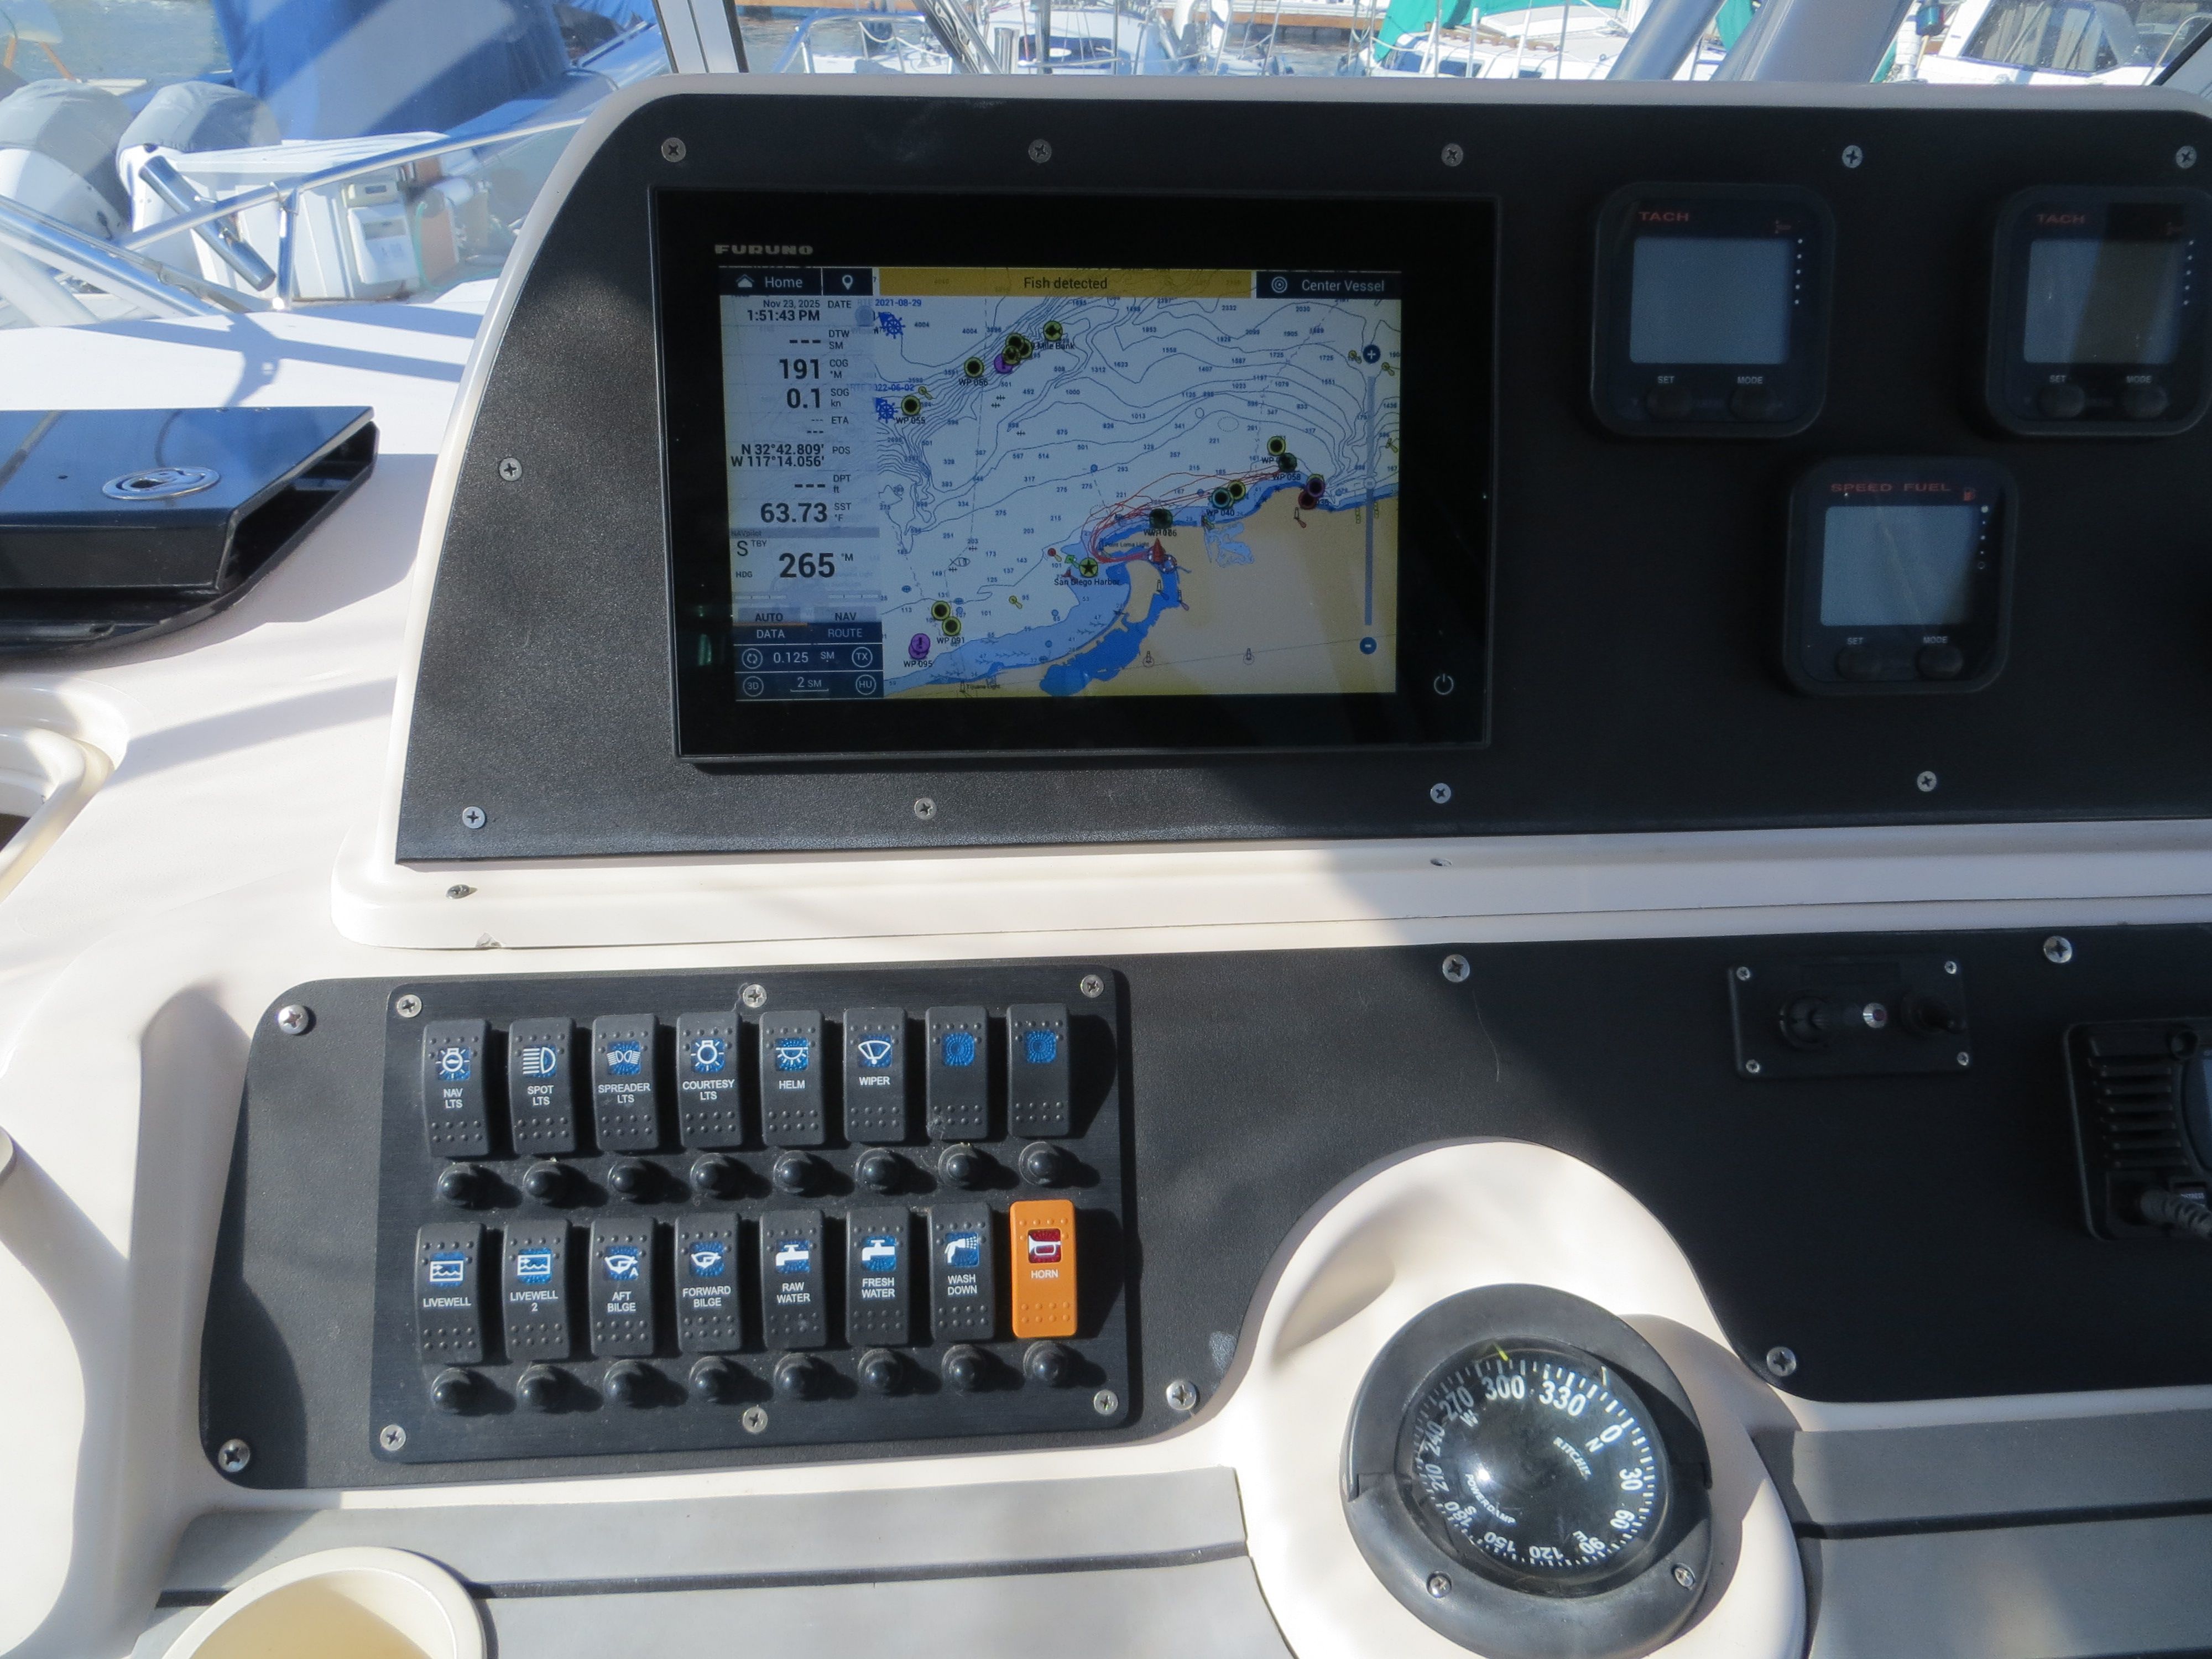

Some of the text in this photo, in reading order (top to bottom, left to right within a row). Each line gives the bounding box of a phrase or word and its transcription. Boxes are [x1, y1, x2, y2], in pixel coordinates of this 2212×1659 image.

[1639, 212, 1689, 221] TACH
[2037, 214, 2085, 224] TACH
[714, 244, 814, 255] FURUNO
[765, 276, 803, 288] Home
[1024, 277, 1107, 289] Fish detected
[1302, 280, 1384, 291] Center Vessel
[763, 299, 820, 309] Nov 23, 2025
[828, 300, 852, 309] DATE
[747, 310, 820, 321] 1:51:43 PM
[779, 358, 820, 379] 191
[1738, 376, 1763, 384] MODE
[787, 388, 820, 409] 0.1
[742, 444, 824, 455] N 32°42.809'
[731, 456, 824, 467] W 117°14.056'
[1832, 483, 1892, 492] SPEED
[760, 503, 827, 523] 63.73
[737, 540, 748, 556] S
[779, 553, 835, 577] 265
[1071, 580, 1091, 588] Diego
[755, 613, 783, 622] AUTO
[757, 630, 785, 638] DATA
[828, 629, 862, 637] ROUTE
[773, 653, 808, 663] 0.125
[797, 677, 804, 687] 2
[682, 1079, 734, 1090] COURTESY
[779, 1080, 805, 1089] HELM
[859, 1077, 890, 1086] WIPER
[444, 1088, 463, 1097] NAV
[528, 1086, 554, 1094] SPOT
[598, 1083, 651, 1093] SPREADER
[533, 1097, 550, 1105] LTS
[617, 1094, 635, 1104] LTS
[700, 1092, 717, 1100] LTS
[445, 1099, 463, 1108] LTS
[947, 1274, 975, 1284] WASH
[1031, 1269, 1058, 1279] HORN
[782, 1282, 805, 1292] RAW
[862, 1277, 895, 1287] FRESH
[682, 1286, 731, 1297] FORWARD
[862, 1288, 895, 1298] WATER
[947, 1285, 978, 1295] DOWN
[510, 1291, 559, 1301] LIVEWELL
[612, 1291, 632, 1301] AFT
[776, 1293, 811, 1303] WATER
[422, 1297, 472, 1308] LIVEWELL
[531, 1303, 538, 1312] 2
[608, 1303, 637, 1312] BILGE
[693, 1298, 722, 1308] BILGE
[1485, 1375, 1525, 1400] 300
[1439, 1386, 1474, 1421] 270
[1539, 1381, 1586, 1416] 330
[1459, 1410, 1480, 1428] W
[1423, 1420, 1446, 1457] 240
[1600, 1424, 1624, 1444] 0
[1585, 1437, 1604, 1454] N
[1424, 1463, 1449, 1494] 210
[1619, 1468, 1644, 1491] 30
[1443, 1501, 1474, 1530] 180
[1464, 1505, 1477, 1516] S
[1610, 1509, 1635, 1530] 60
[1484, 1531, 1516, 1554] 150
[1572, 1530, 1587, 1545] E
[1578, 1536, 1606, 1556] 90
[1529, 1545, 1564, 1561] 120
